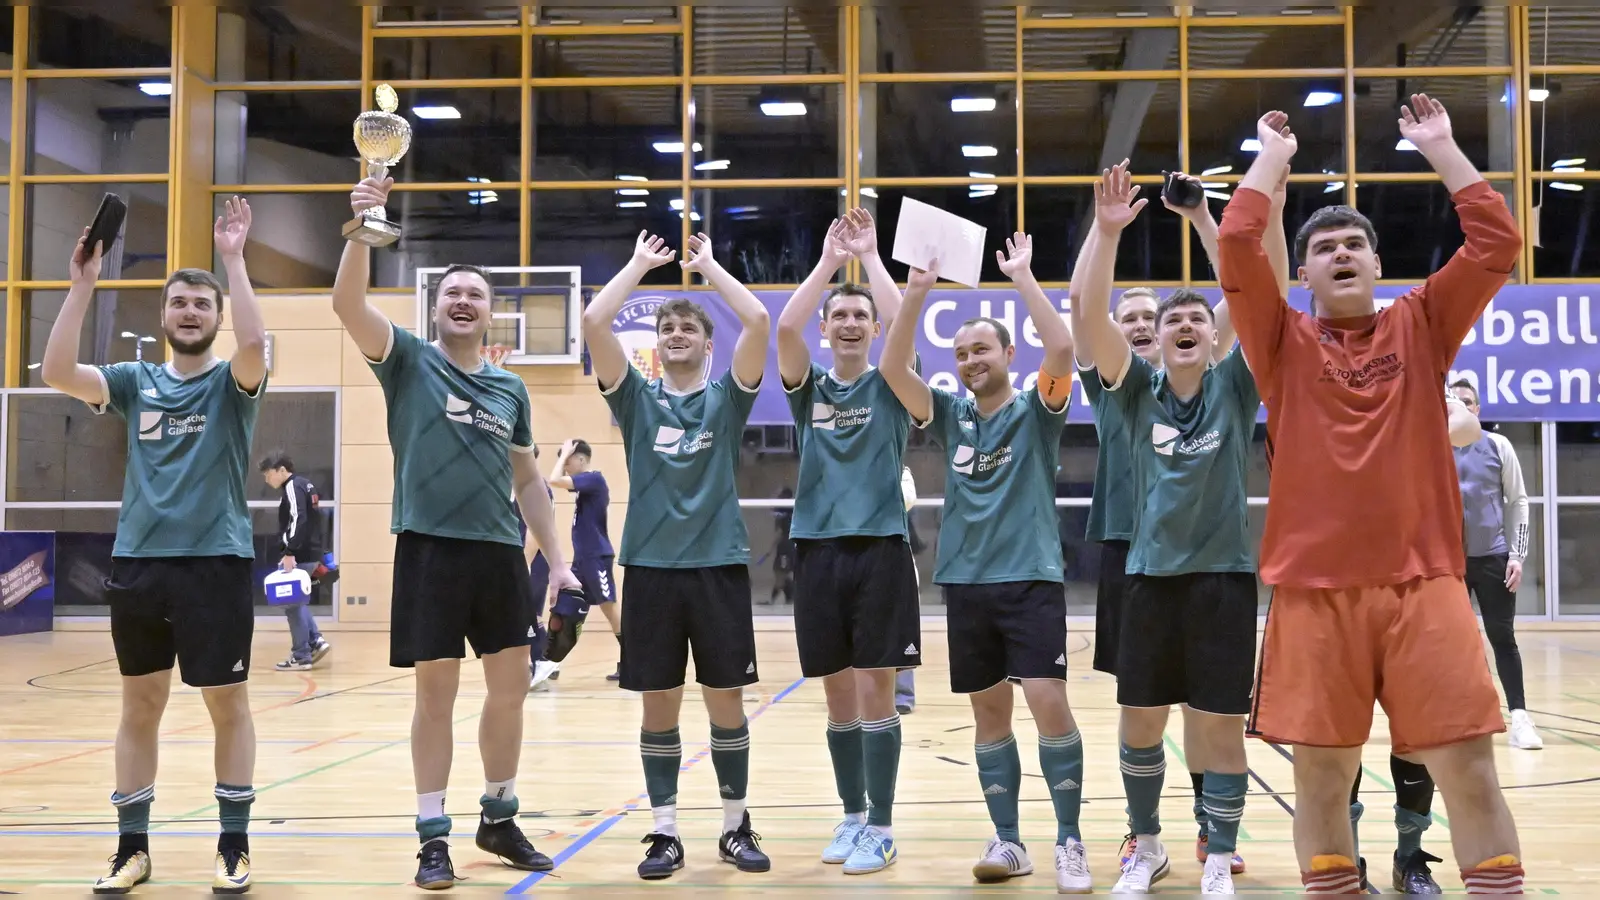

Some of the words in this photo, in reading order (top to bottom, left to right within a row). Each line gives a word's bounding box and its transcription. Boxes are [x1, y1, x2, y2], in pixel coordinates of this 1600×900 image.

[835, 406, 872, 418] Deutsche
[168, 414, 207, 426] Deusche
[837, 415, 873, 427] Glasfaser
[168, 424, 207, 436] Glasfaser
[979, 446, 1012, 462] Duche
[977, 454, 1012, 472] Glasfaser
